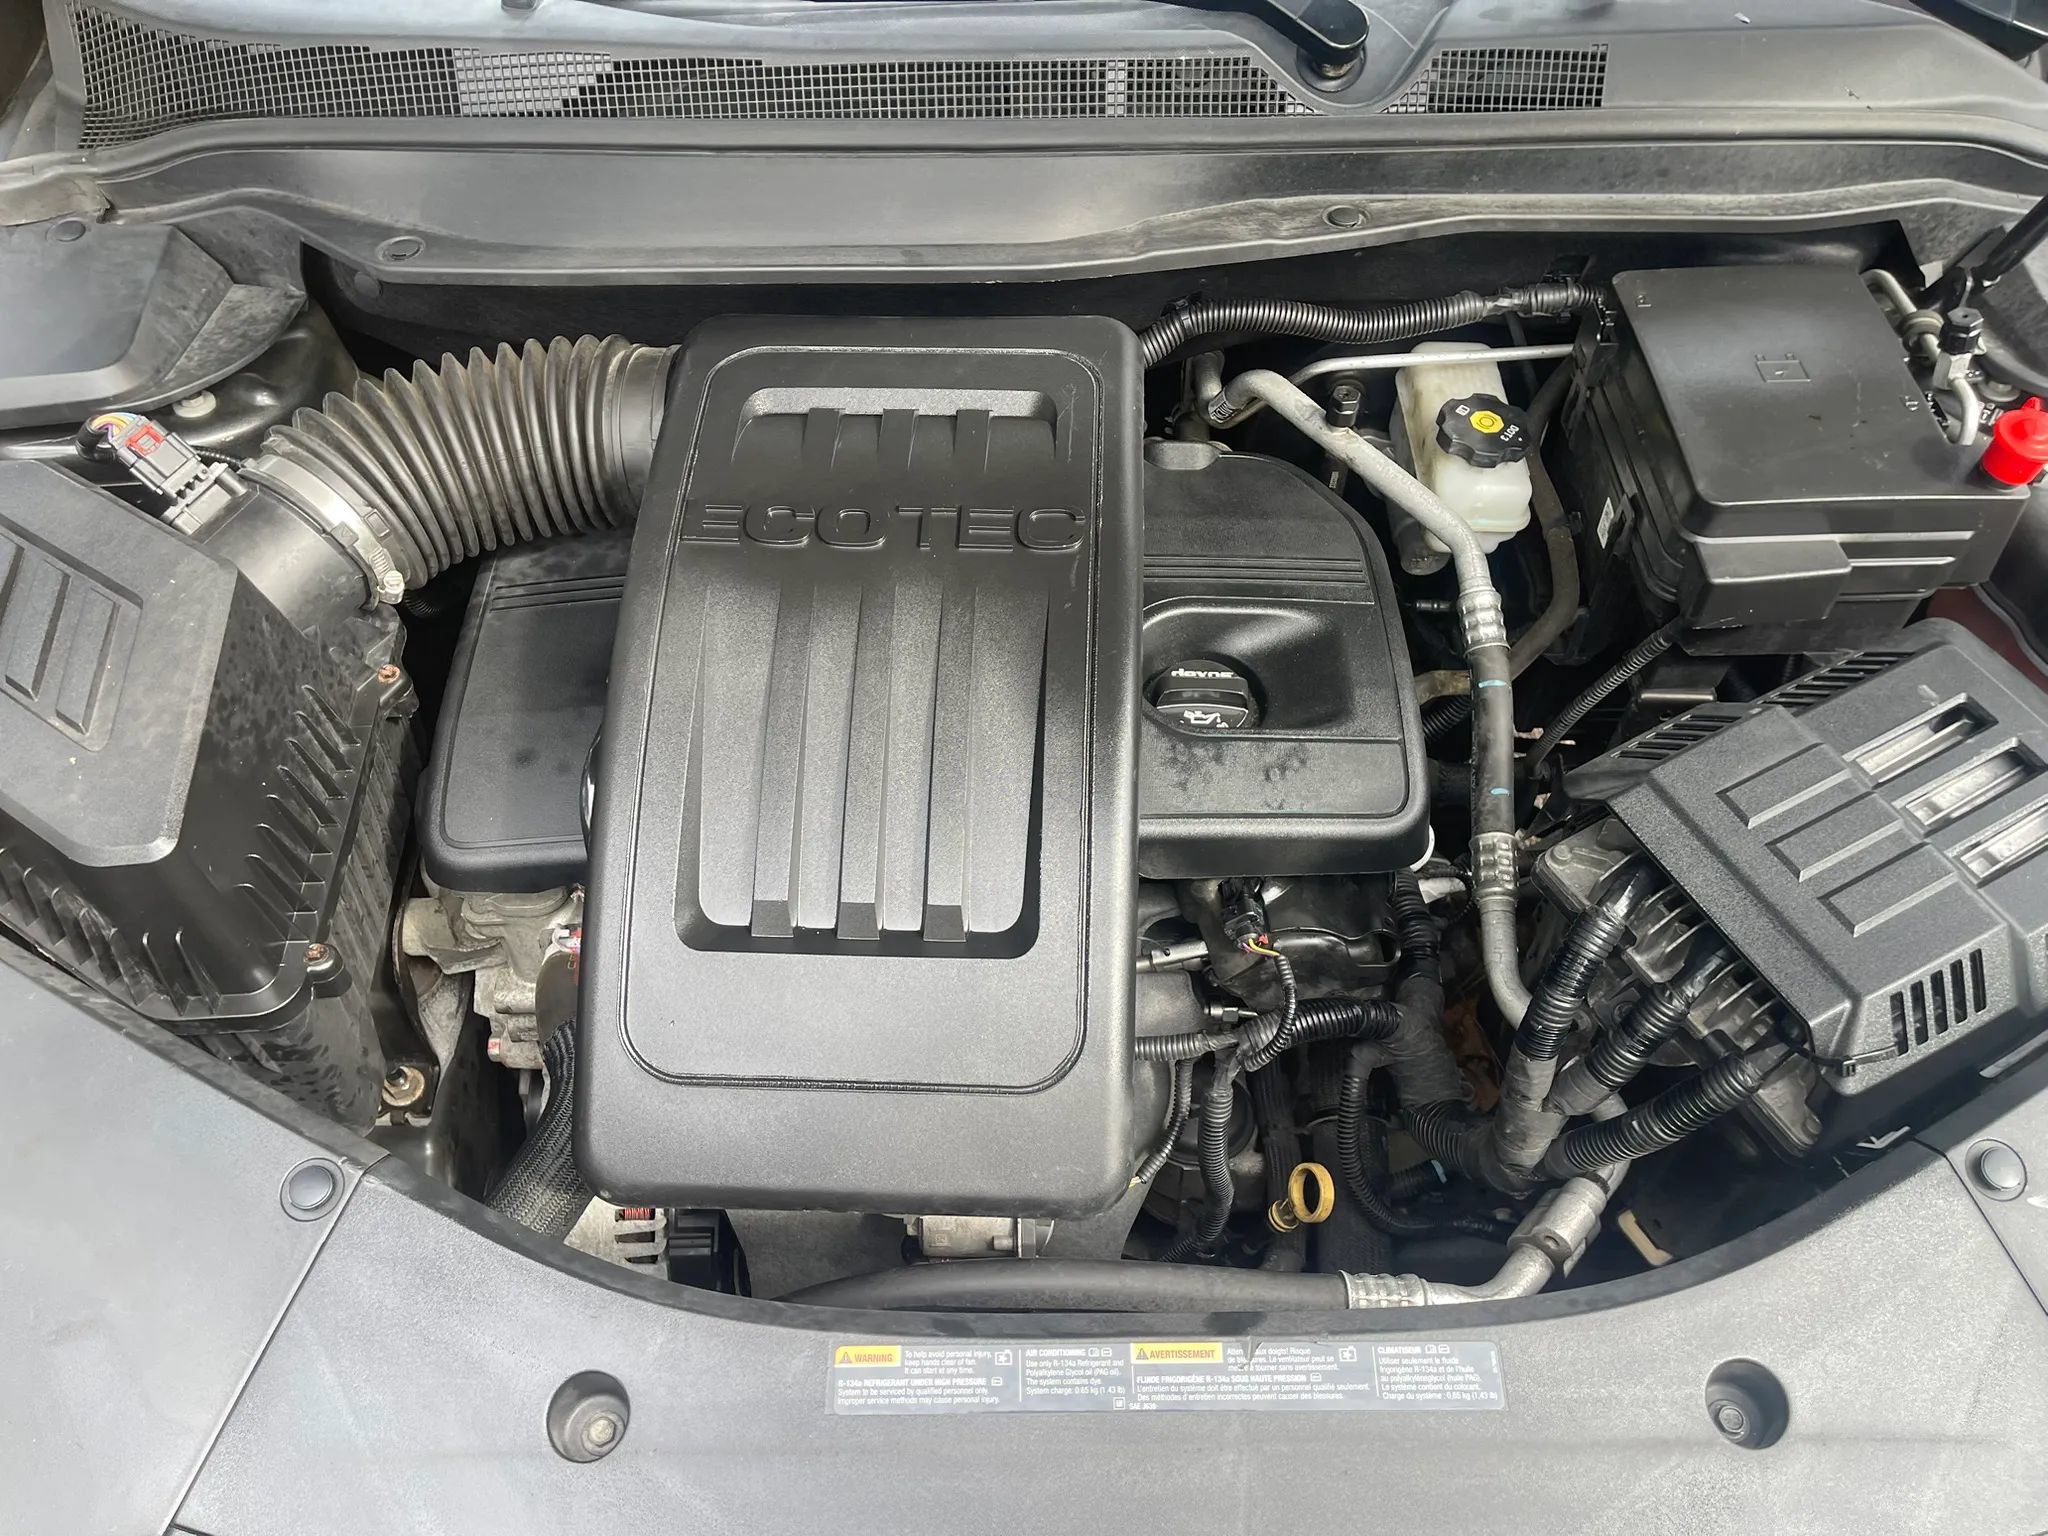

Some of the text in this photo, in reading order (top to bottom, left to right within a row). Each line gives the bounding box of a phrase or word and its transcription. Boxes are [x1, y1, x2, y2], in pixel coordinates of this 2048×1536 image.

[682, 504, 1086, 552] ECOTEC
[928, 1350, 944, 1358] avoid
[946, 1350, 972, 1359] personal
[1026, 1349, 1086, 1357] AIR CONDITIONING
[1150, 1350, 1216, 1359] AVERTISSEMENT
[854, 1353, 893, 1363] WARNING
[1039, 1360, 1052, 1368] only
[1077, 1360, 1111, 1368] Refrigerant
[864, 1379, 909, 1387] REFRIGERANT
[952, 1378, 987, 1386] PRESSURE
[1039, 1378, 1062, 1386] system
[1136, 1376, 1160, 1384] FLUIDE
[1026, 1387, 1050, 1395] System
[1281, 1383, 1311, 1392] personnel
[838, 1388, 861, 1397] System
[879, 1388, 906, 1396] serviced
[916, 1388, 942, 1397] qualified
[943, 1388, 974, 1396] personnel
[953, 1397, 980, 1405] personal
